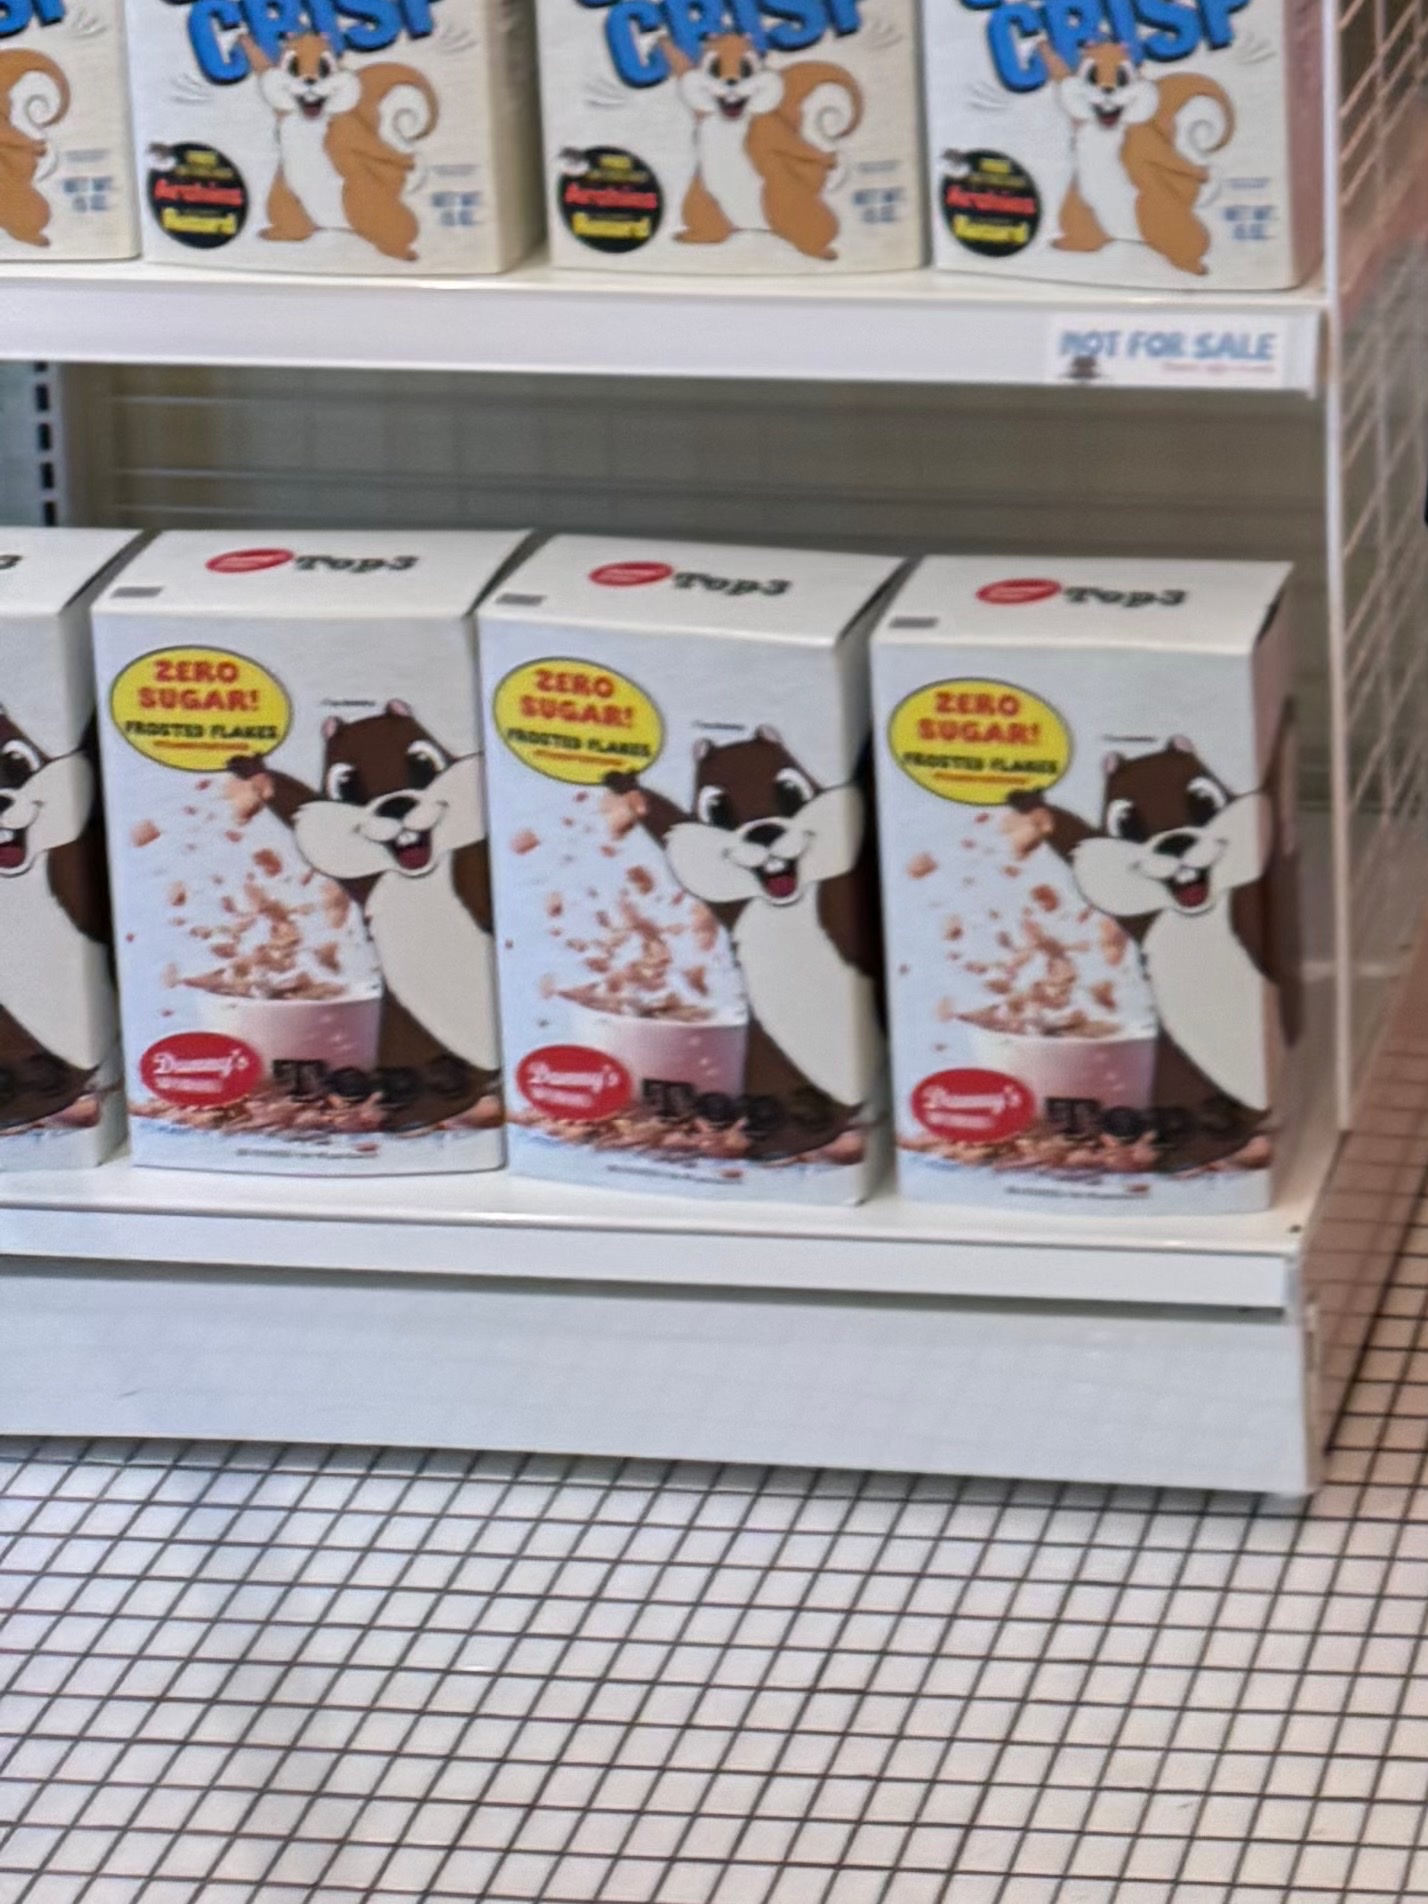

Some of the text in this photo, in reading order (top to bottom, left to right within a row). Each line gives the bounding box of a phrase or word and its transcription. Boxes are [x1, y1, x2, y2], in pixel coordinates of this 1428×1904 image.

[1193, 332, 1276, 360] SALE
[153, 660, 240, 684] ZERO
[534, 668, 616, 699] ZERO
[138, 687, 260, 712] SUGAR!
[519, 695, 634, 729] SUGAR!
[934, 690, 1021, 717] ZERO
[917, 717, 1041, 745] SUGAR!
